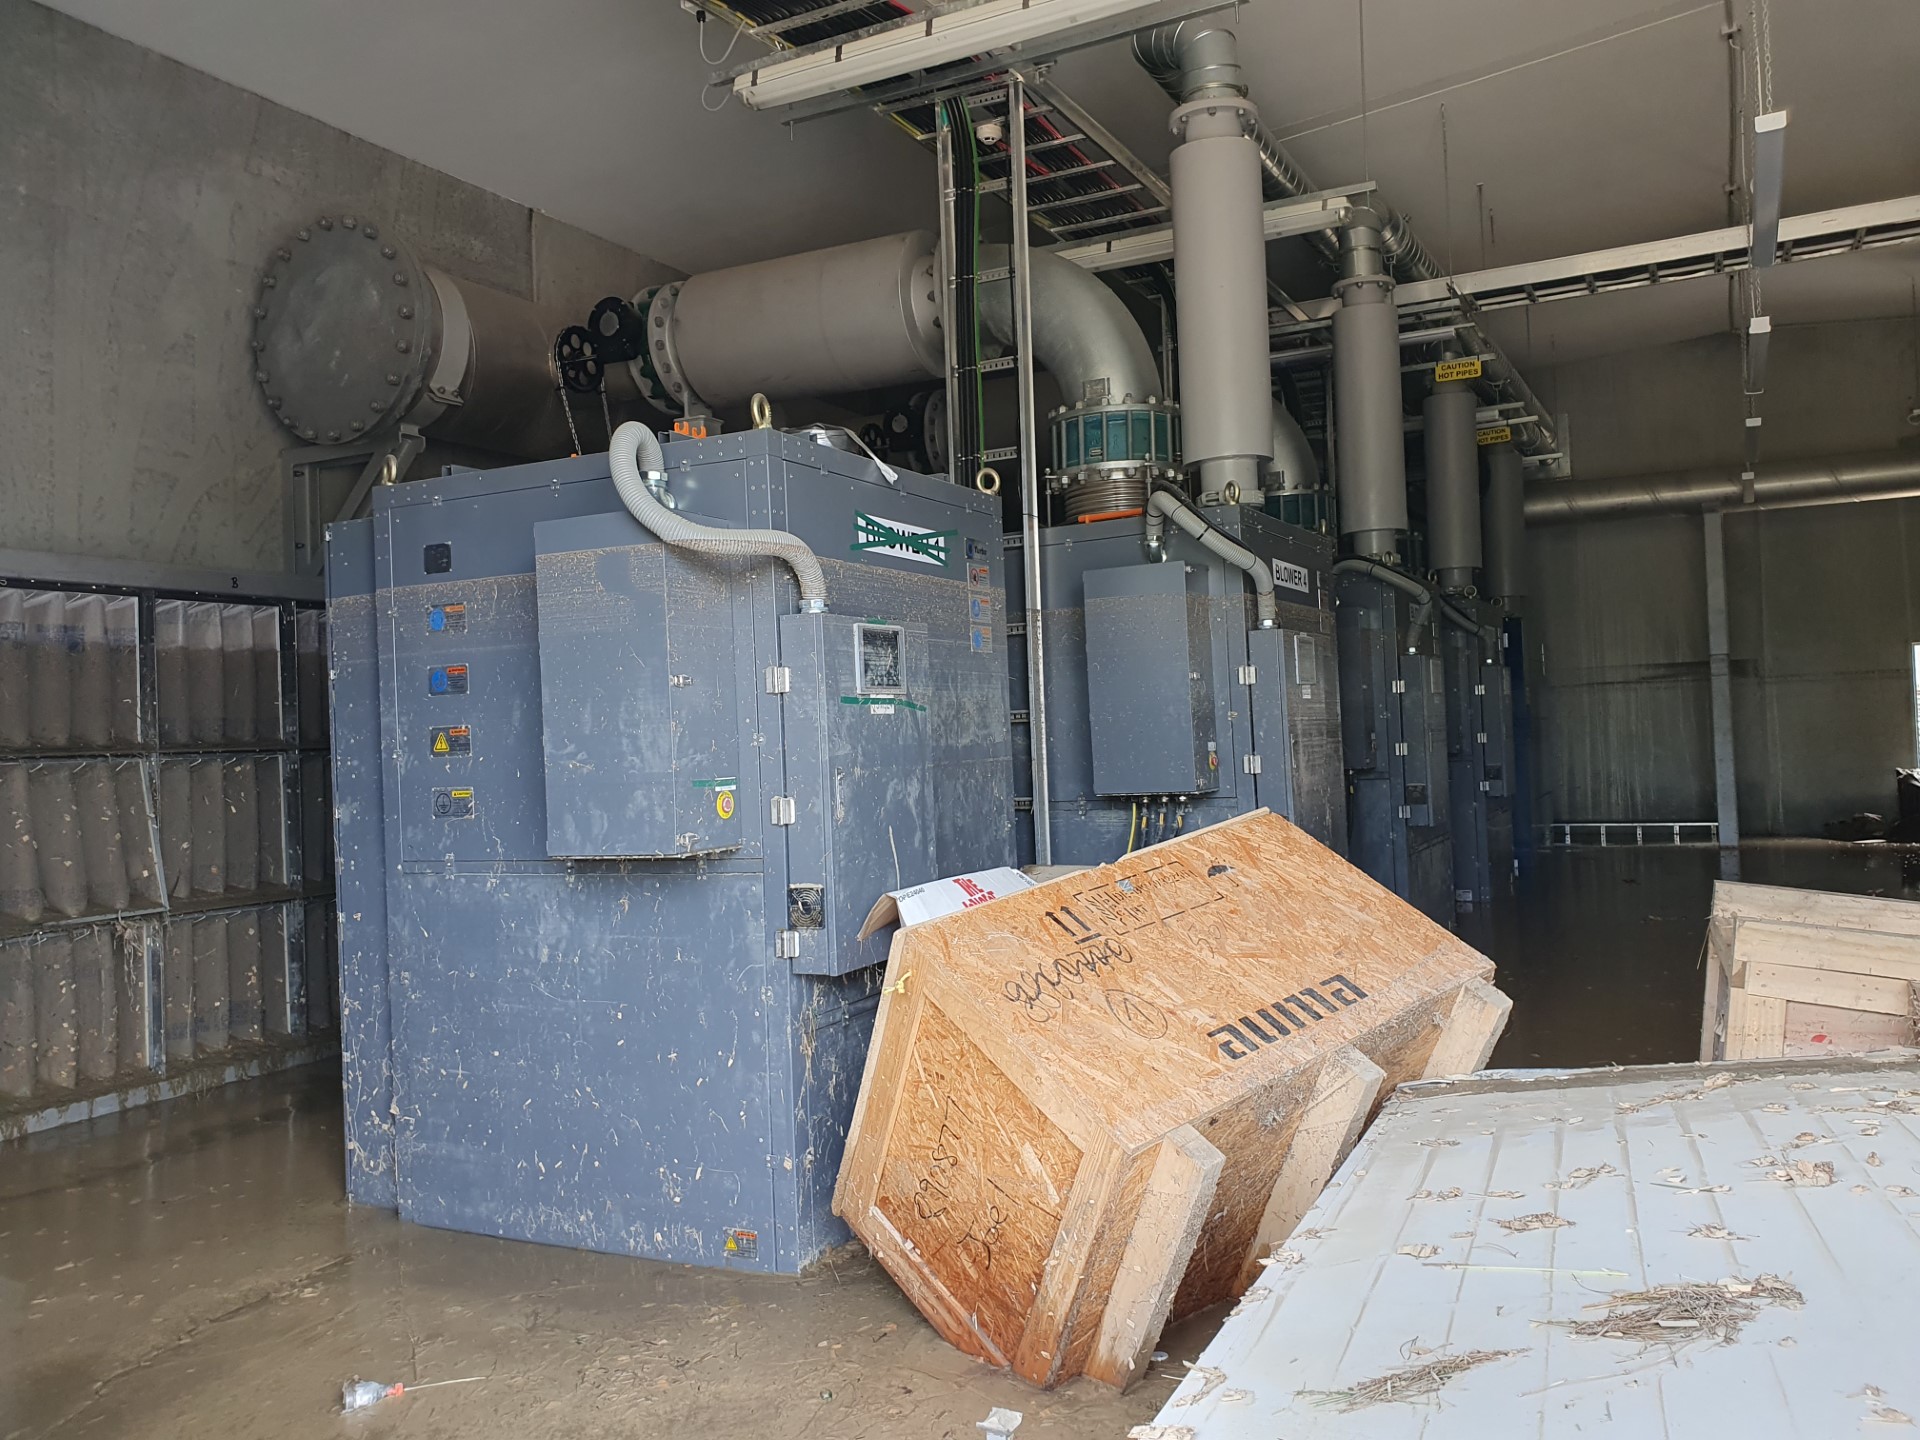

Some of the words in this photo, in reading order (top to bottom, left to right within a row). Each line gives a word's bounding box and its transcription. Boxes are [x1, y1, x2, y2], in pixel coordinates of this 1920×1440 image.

[1441, 361, 1475, 371] CAUTION
[1438, 372, 1454, 380] HOT
[1456, 369, 1479, 378] PIPES
[1477, 428, 1506, 437] CAUTION
[1490, 434, 1509, 442] PIPES
[1275, 563, 1302, 587] BLOWER
[1303, 573, 1308, 588] 4
[231, 576, 239, 589] B
[952, 877, 985, 897] THE
[1207, 974, 1369, 1060] auma
